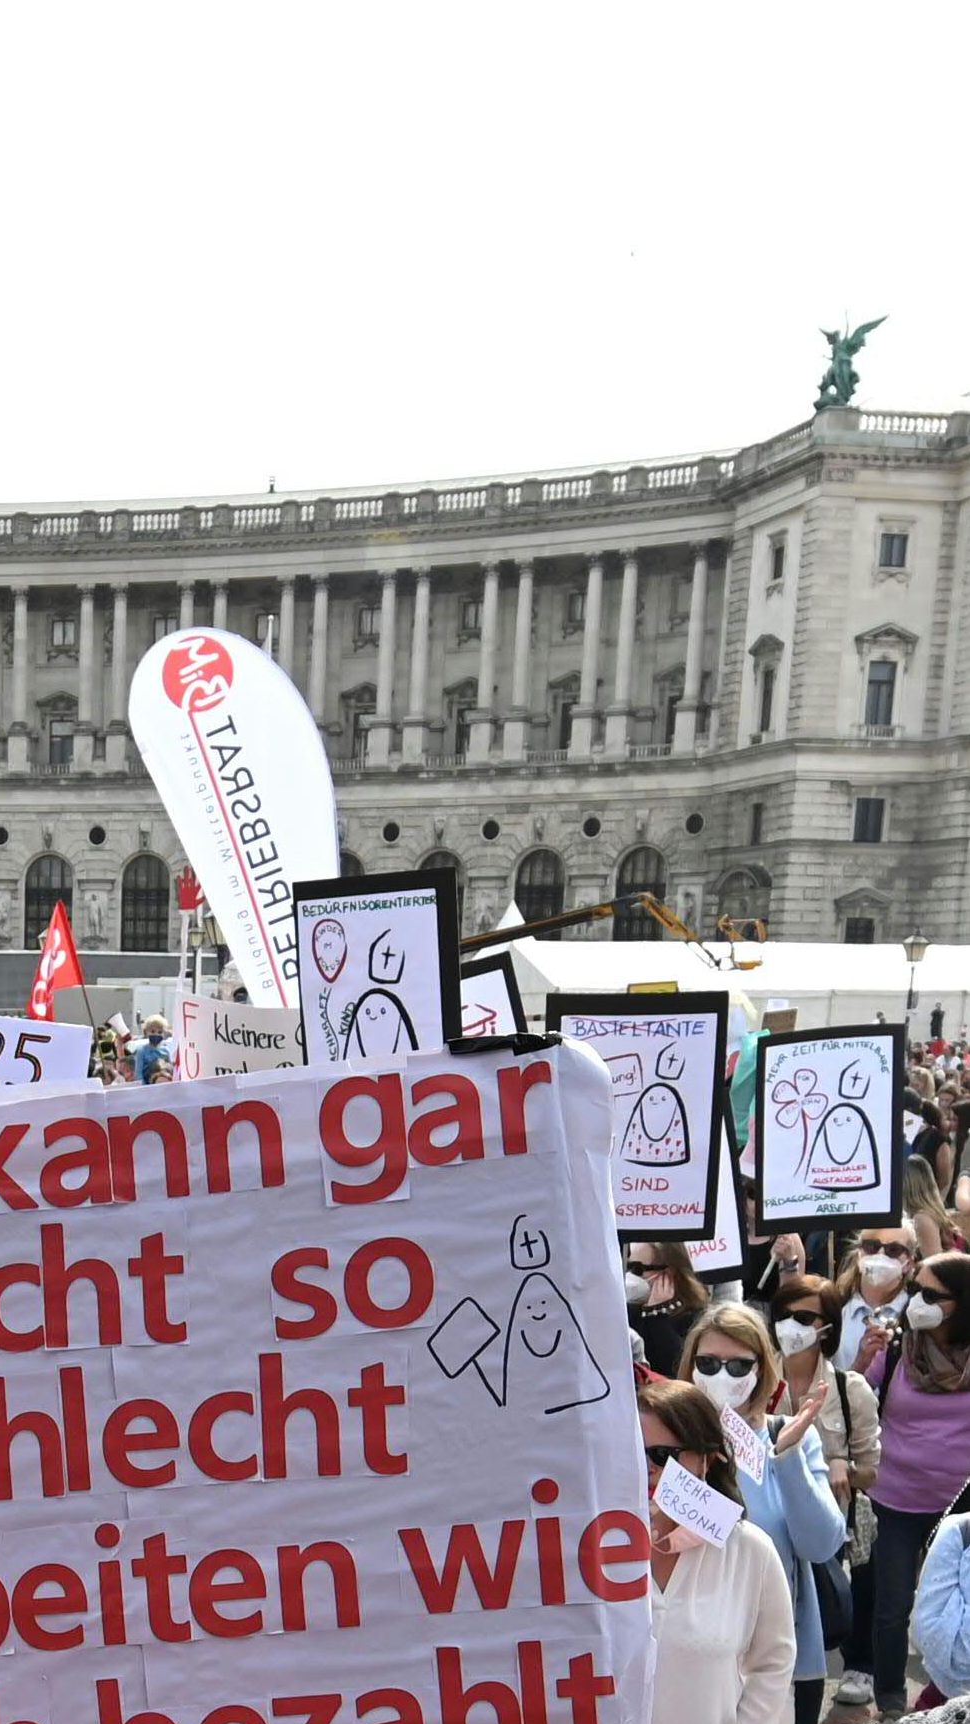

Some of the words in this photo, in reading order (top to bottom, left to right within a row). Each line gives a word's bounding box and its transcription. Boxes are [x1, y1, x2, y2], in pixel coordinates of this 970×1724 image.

[213, 1012, 286, 1049] kleinere
[572, 1019, 707, 1037] BASTELTANTE
[766, 1053, 788, 1083] MEHR
[792, 1042, 818, 1057] ZEIT
[822, 1039, 841, 1051] FÜR
[842, 1041, 890, 1074] MITTELBARE
[318, 1061, 551, 1203] gar
[621, 1176, 669, 1192] SIND
[765, 1193, 838, 1208] PÄDAGOGISCHE
[615, 1203, 705, 1217] GSPERSONAL
[816, 1202, 858, 1214] ARBEIT
[272, 1237, 433, 1340] so
[675, 1470, 711, 1504] MEHR
[659, 1482, 725, 1542] PERSONAL
[400, 1479, 652, 1612] wie
